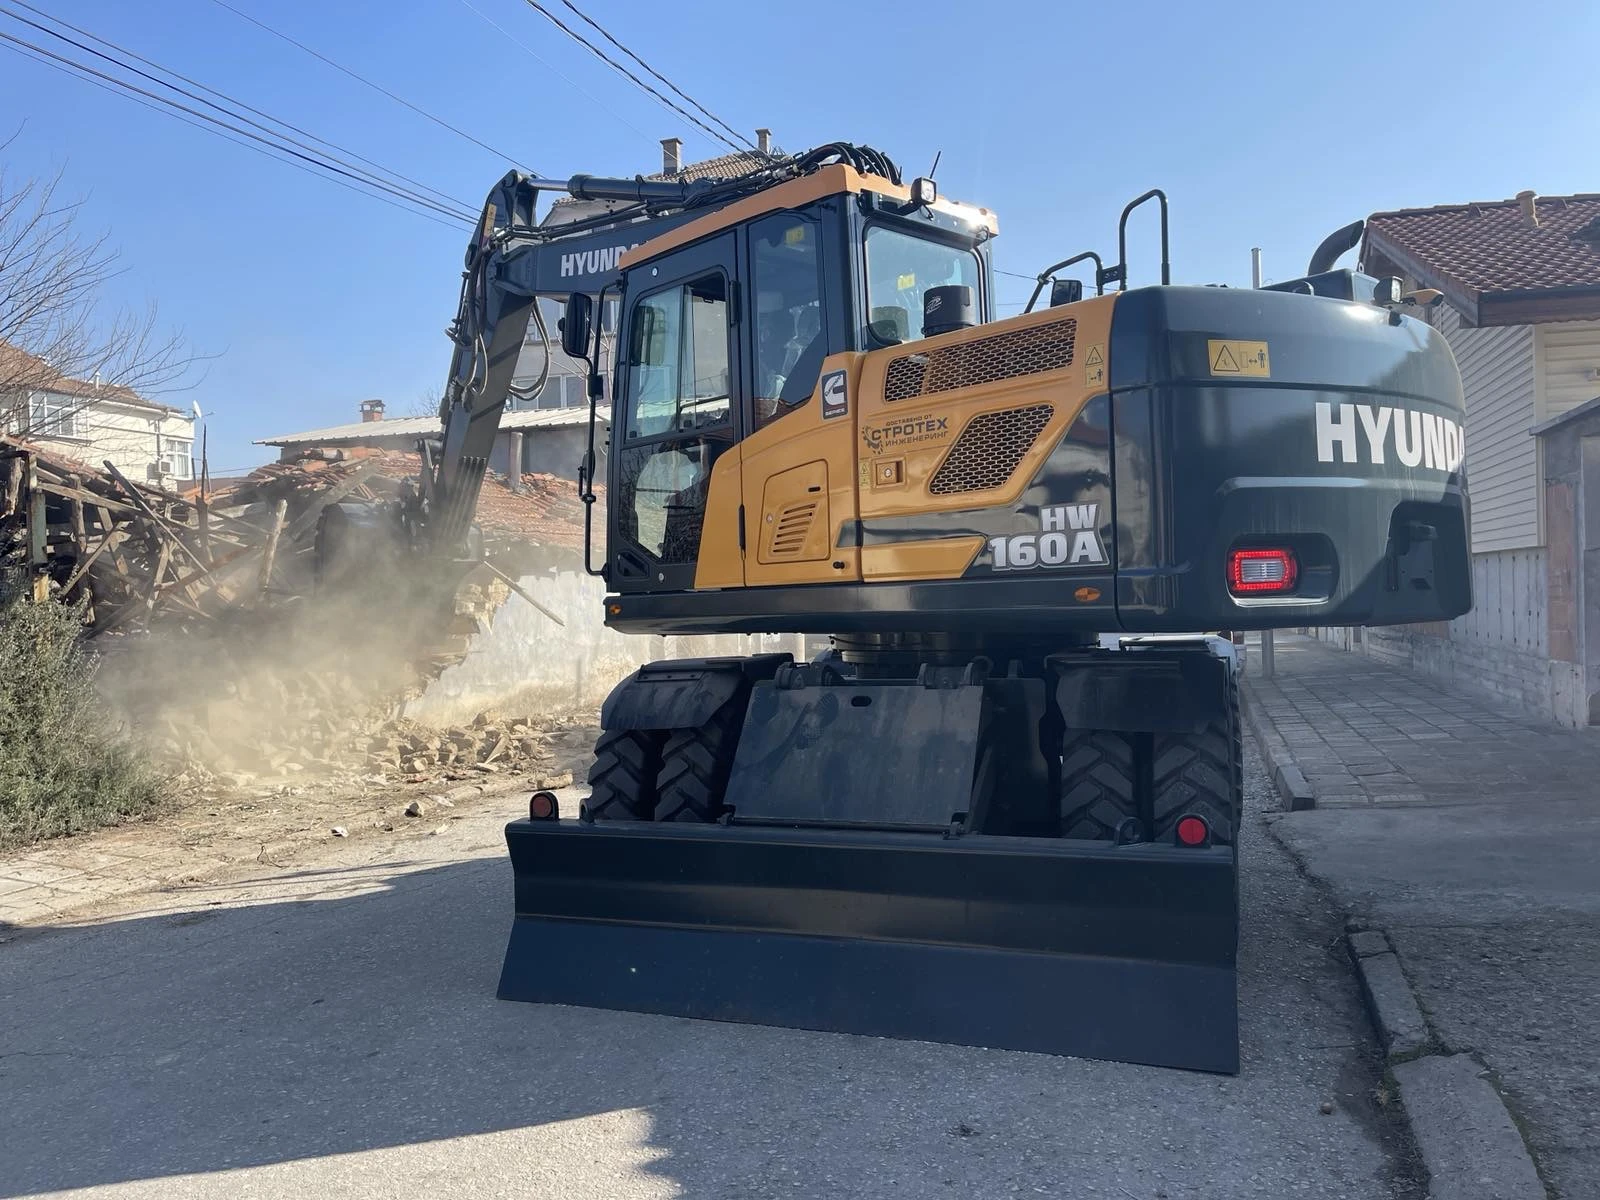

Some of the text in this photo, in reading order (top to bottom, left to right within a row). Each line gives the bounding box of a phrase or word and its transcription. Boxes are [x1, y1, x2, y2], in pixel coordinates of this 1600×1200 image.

[560, 243, 639, 277] HYUND
[871, 417, 948, 440] СТРОТЕХ
[885, 431, 949, 447] ИНЖЕНЕРИНГ
[1041, 504, 1098, 532] HW
[989, 531, 1103, 567] 160A
